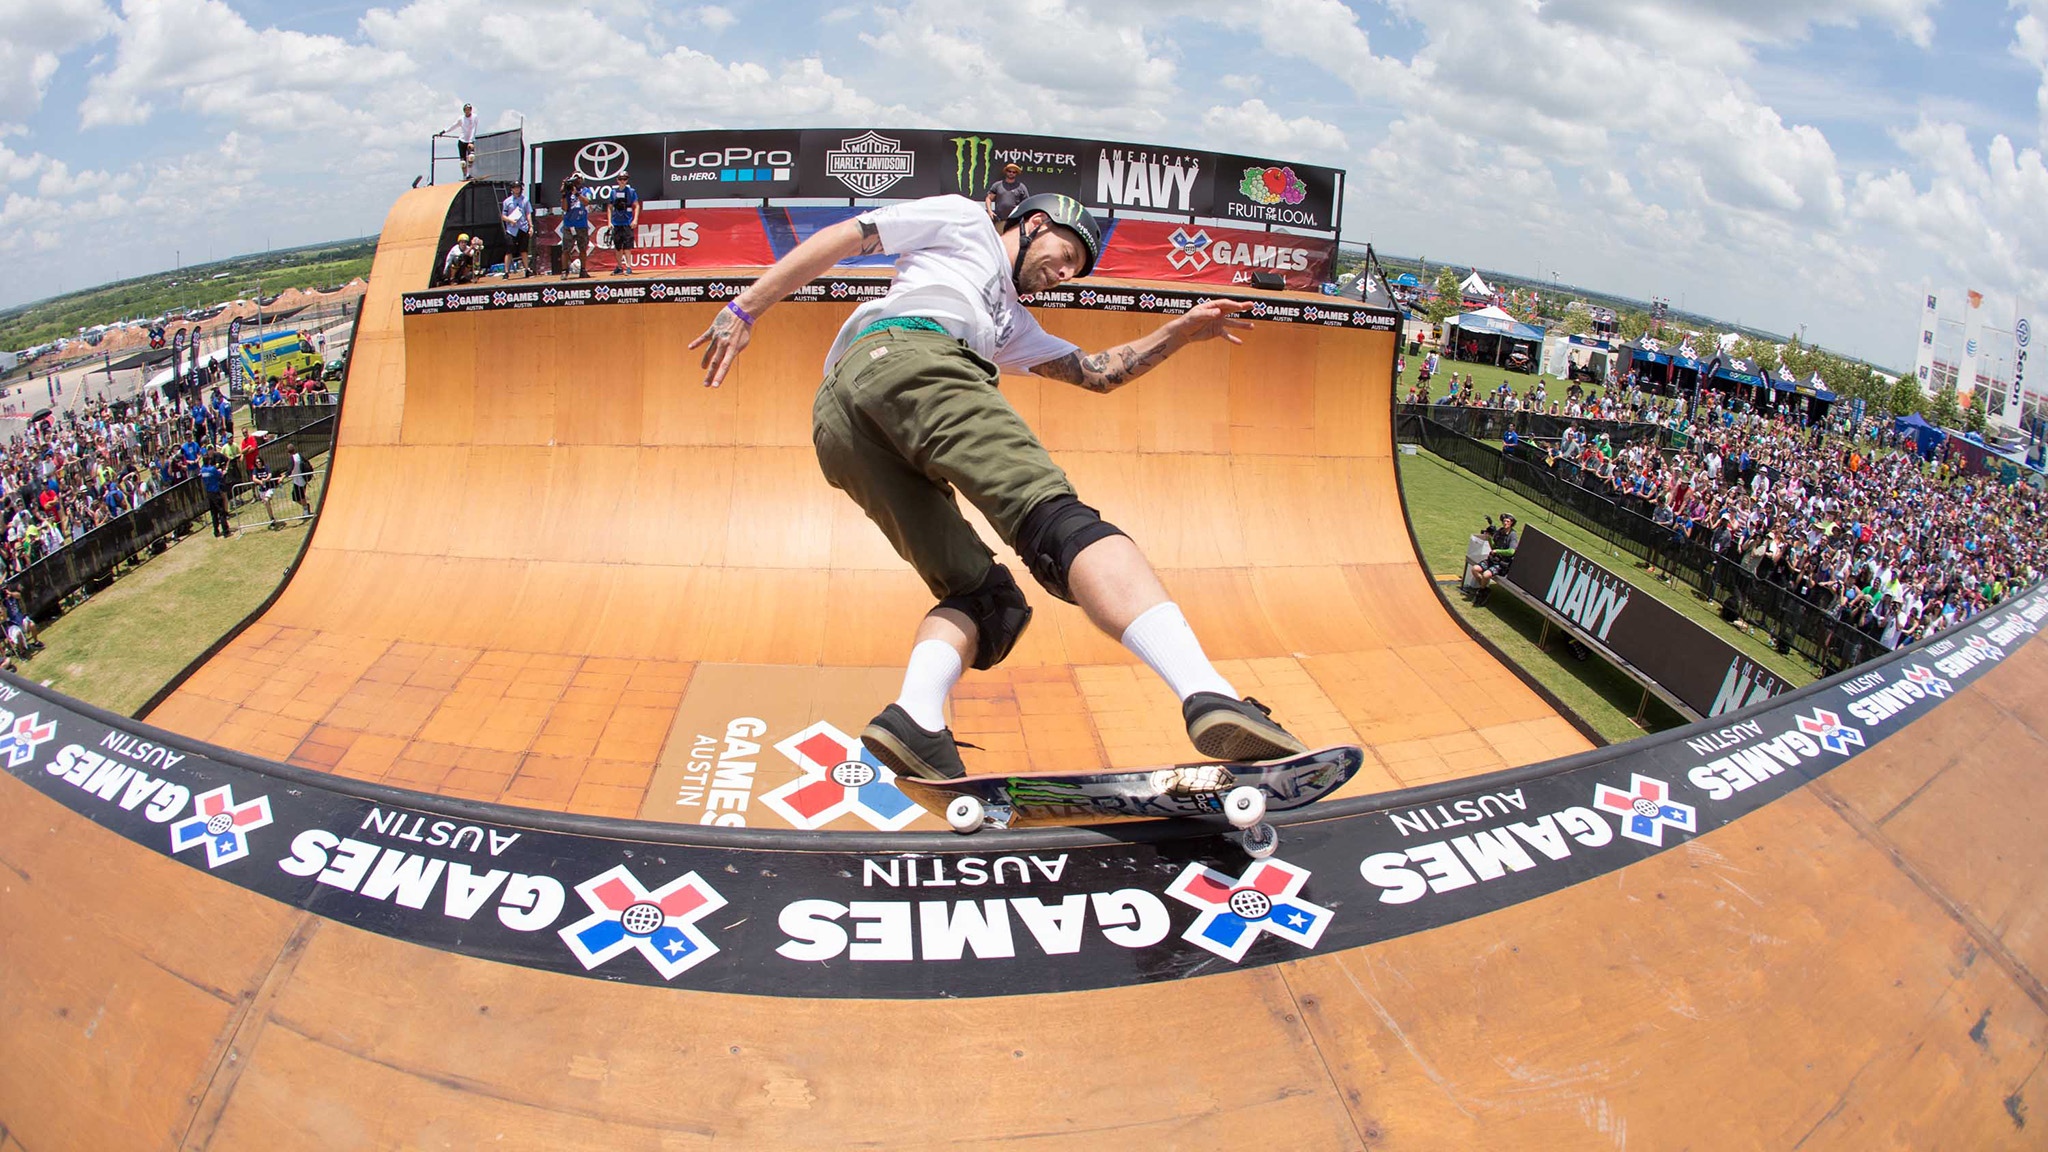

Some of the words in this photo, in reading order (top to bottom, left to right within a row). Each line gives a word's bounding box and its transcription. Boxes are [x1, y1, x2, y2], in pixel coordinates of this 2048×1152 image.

[852, 139, 890, 153] MOTOR
[670, 148, 792, 168] GoPro
[834, 157, 906, 170] HARLEY-DAVIDSON
[994, 148, 1076, 166] MONSTER
[688, 172, 717, 180] HERO.
[850, 174, 888, 189] CYCLES
[1097, 159, 1199, 210] NAVY
[1228, 202, 1265, 219] FRUIT
[1212, 241, 1308, 271] GAMES
[507, 292, 539, 303] GAMES
[557, 289, 591, 300] GAMES
[610, 288, 646, 297] GAMES
[666, 286, 704, 296] GAMES
[725, 286, 750, 295] GAM
[792, 286, 826, 295] AMES
[848, 286, 888, 295] GAMES
[1035, 290, 1074, 301] GAMES
[1096, 294, 1135, 305] GAMES
[416, 298, 443, 308] GAMES
[460, 295, 489, 305] GAMES
[1156, 298, 1192, 308] GAMES
[1266, 306, 1300, 316] GAMES
[1318, 310, 1349, 321] GAMES
[1366, 315, 1395, 326] GAMES
[2012, 349, 2027, 406] Seton
[1546, 561, 1628, 641] NAVY
[1925, 639, 1956, 657] AUSTIN
[1934, 646, 1986, 678] GAMES
[1732, 656, 1783, 696] AMERI
[1840, 671, 1886, 696] AUSTIN
[1848, 679, 1925, 726] GAMES
[1688, 720, 1763, 755] AUSTIN
[100, 730, 185, 770] AUSTIN
[676, 734, 717, 806] AUSTIN
[1688, 730, 1820, 800] GAMES
[46, 744, 190, 823] GAMES
[1390, 788, 1527, 837] AUSTIN
[361, 807, 521, 856] AUSTIN
[1360, 806, 1613, 905] GAMES
[863, 854, 1068, 887] AUSTIN
[278, 829, 565, 932] GAMES
[775, 889, 1172, 962] GAMES
